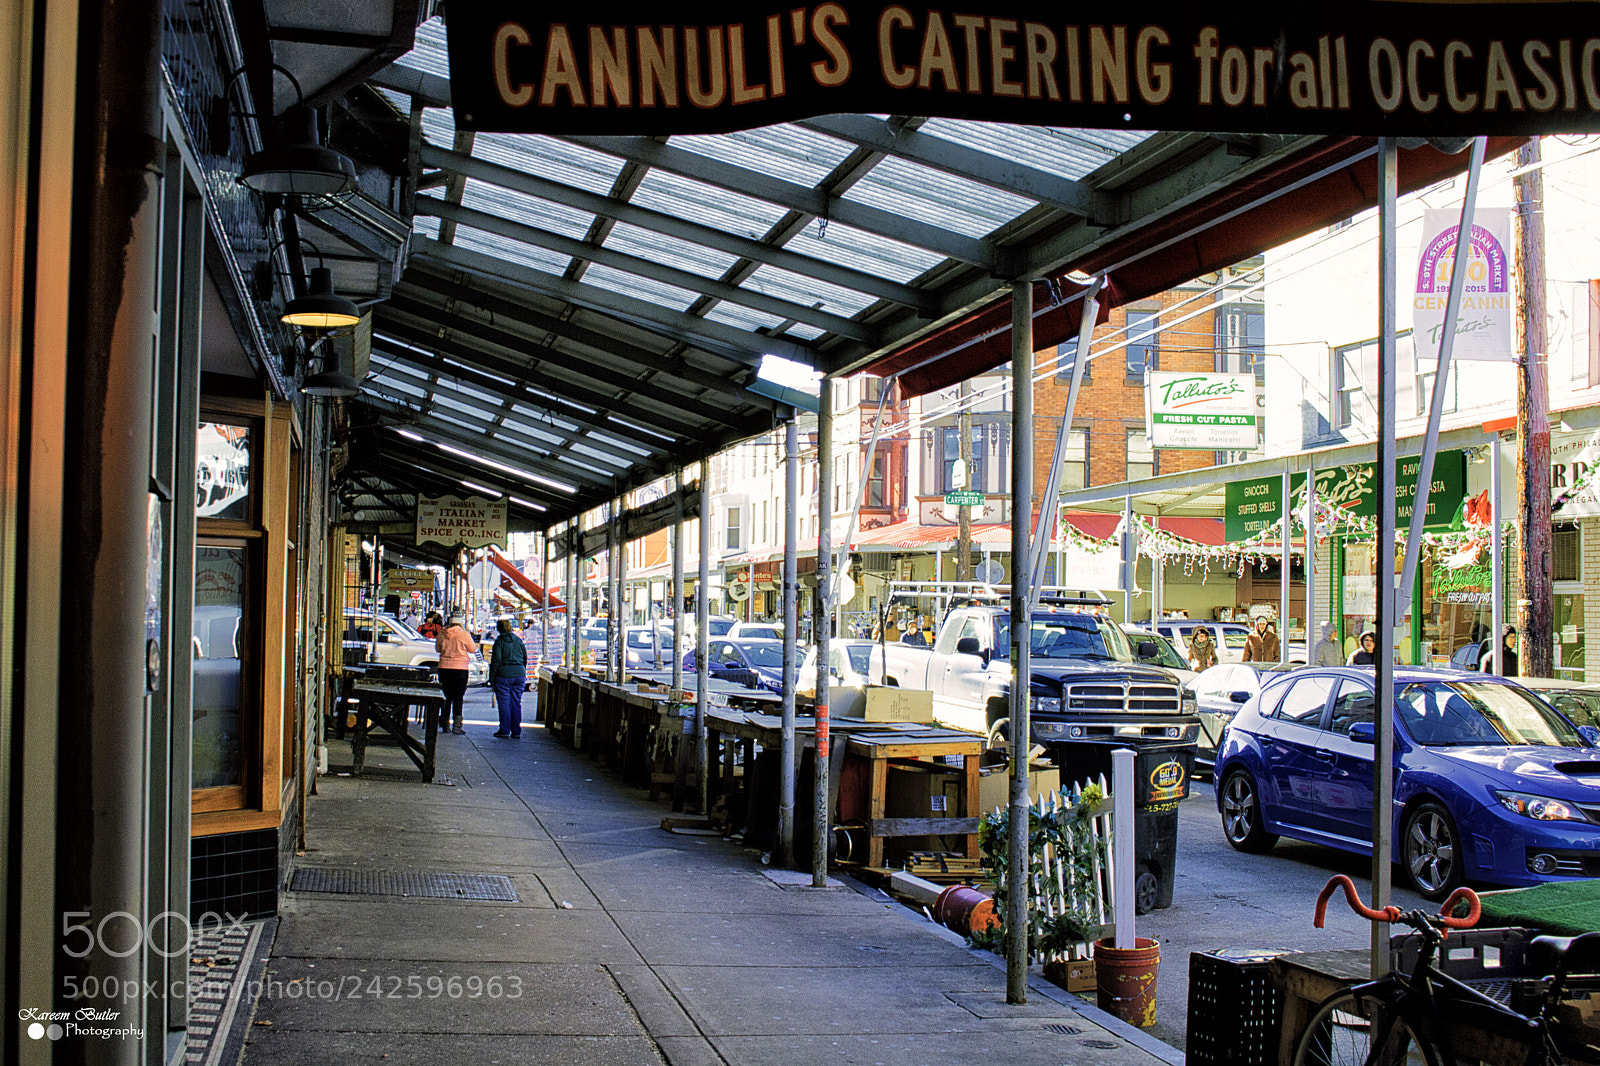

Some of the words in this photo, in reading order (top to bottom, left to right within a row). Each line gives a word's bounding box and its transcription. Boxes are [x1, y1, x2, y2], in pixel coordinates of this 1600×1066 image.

[492, 2, 852, 109] CANNULI'S
[878, 3, 1173, 106] CATERING
[1194, 24, 1275, 107] for
[1289, 32, 1351, 109] all
[1423, 258, 1433, 279] 9TH
[1490, 249, 1502, 289] MARKET
[1437, 261, 1486, 282] 10
[1465, 285, 1486, 293] 2015
[1160, 377, 1245, 405] Talluto's
[1163, 415, 1193, 423] FRESH
[1196, 415, 1216, 424] CUT
[1219, 416, 1248, 424] PASTA
[1244, 484, 1269, 497] GNOCCHI
[1429, 480, 1446, 493] ASTA
[946, 495, 979, 504] CARPENTER
[440, 508, 485, 517] ITALIAN
[1238, 504, 1258, 515] STUFFED
[1259, 501, 1276, 512] SHELLS
[438, 519, 486, 528] MARKET
[420, 528, 453, 536] SPICE
